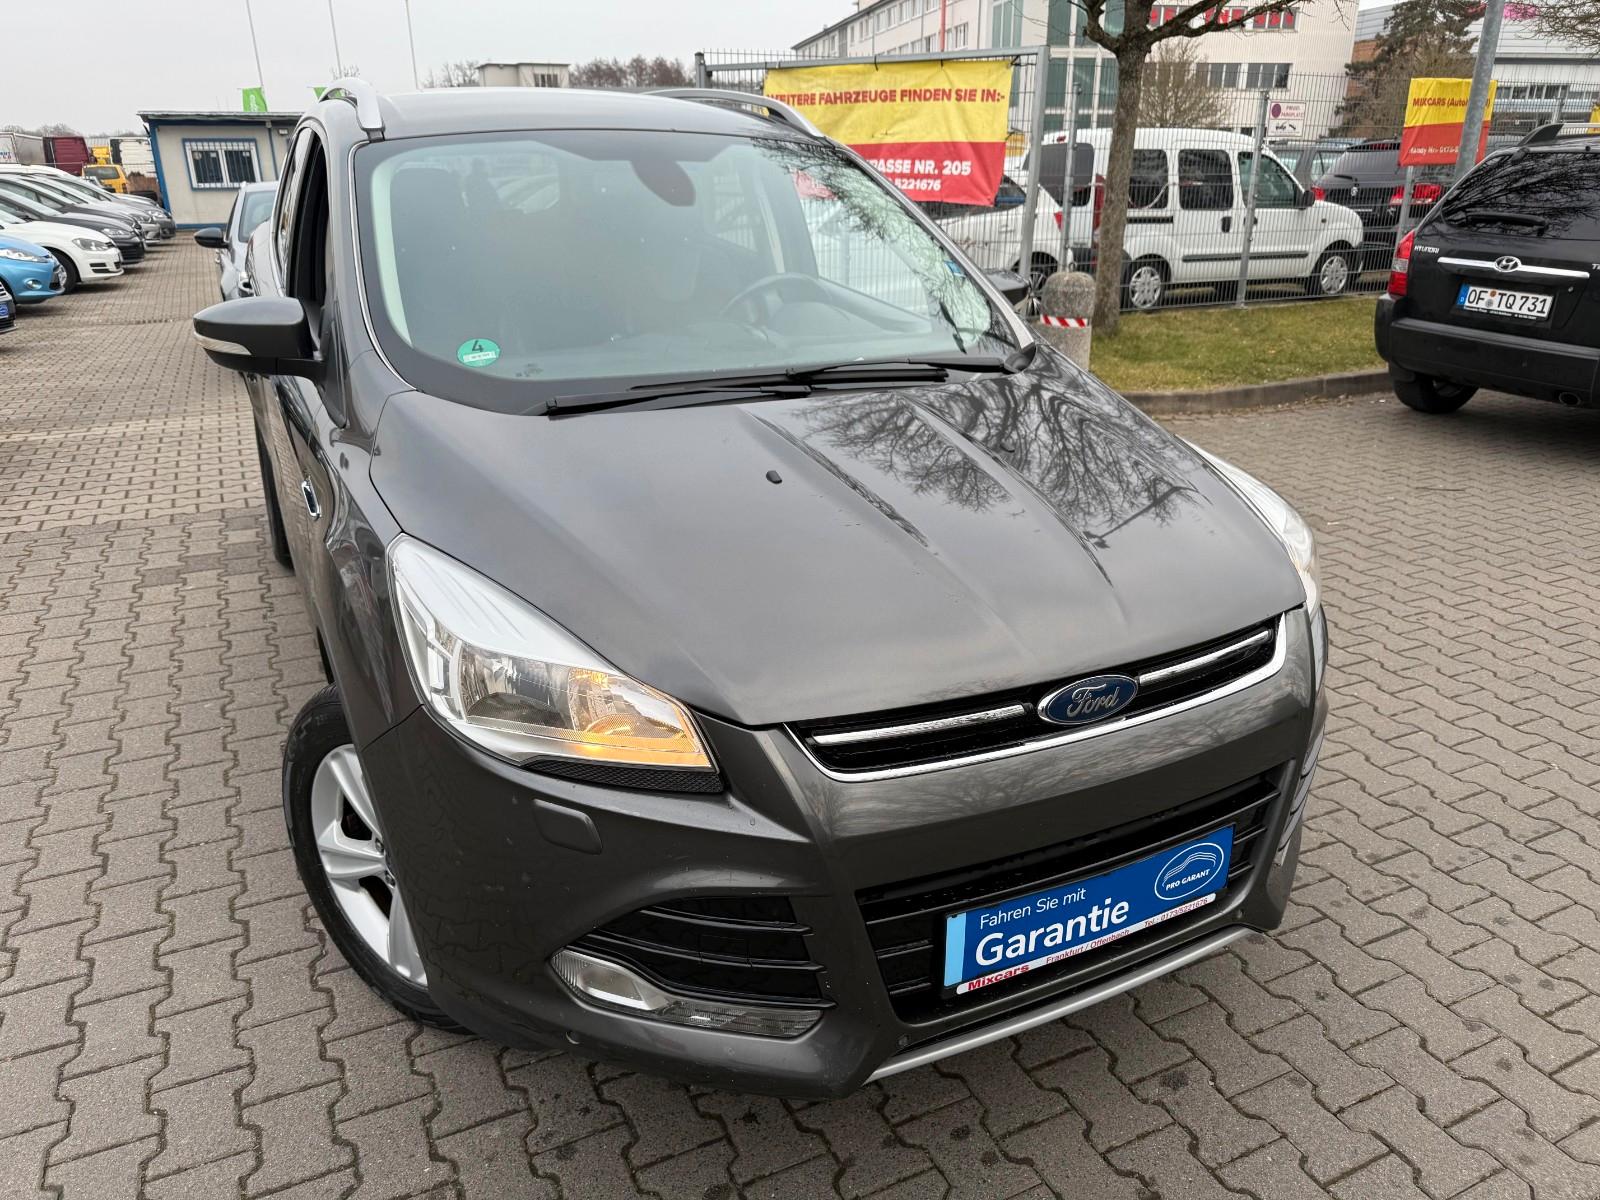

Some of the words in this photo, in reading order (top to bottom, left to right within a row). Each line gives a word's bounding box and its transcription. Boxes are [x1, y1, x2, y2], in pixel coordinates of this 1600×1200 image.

[819, 90, 897, 105] FAHRZEUGE
[900, 88, 952, 102] FINDEN
[955, 88, 977, 102] SIE
[1412, 97, 1446, 107] MIXCARS
[914, 159, 939, 175] NR.
[942, 160, 972, 176] 205
[1467, 288, 1488, 305] OF
[1497, 292, 1517, 310] TQ
[1518, 295, 1548, 315] 731
[471, 340, 484, 352] 4
[1066, 683, 1120, 718] Ford
[1165, 879, 1181, 891] PRO
[1181, 868, 1211, 888] GARANT
[980, 904, 1031, 930] Fahren
[1036, 896, 1059, 914] Sie
[1062, 887, 1087, 907] mit
[975, 897, 1130, 967] Garantie
[967, 963, 1030, 992] Mixcars
[1046, 945, 1084, 964] Frankfurt
[1090, 929, 1130, 950] Offenbach
